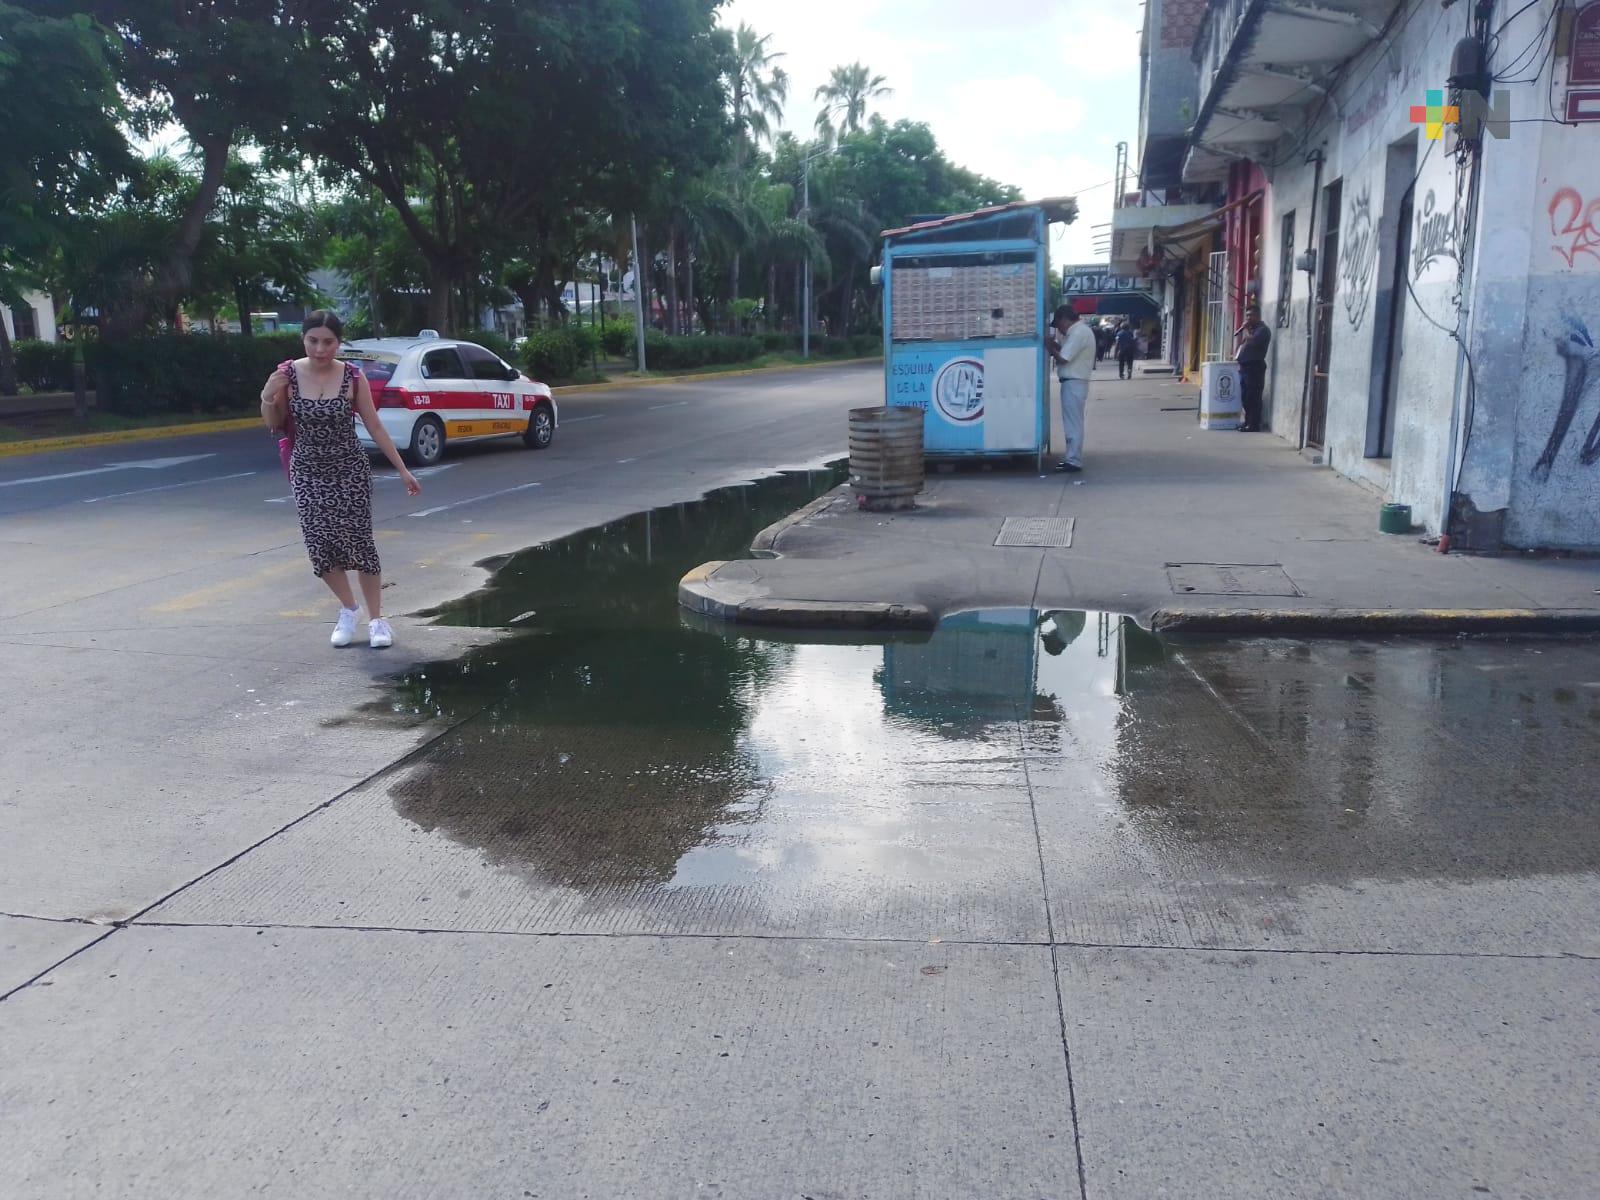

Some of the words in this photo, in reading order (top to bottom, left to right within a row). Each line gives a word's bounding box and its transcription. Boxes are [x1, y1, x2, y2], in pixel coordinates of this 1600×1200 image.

[892, 362, 934, 375] ESQUINA
[896, 382, 909, 393] DE
[913, 381, 925, 392] LA
[492, 393, 511, 409] TAXI
